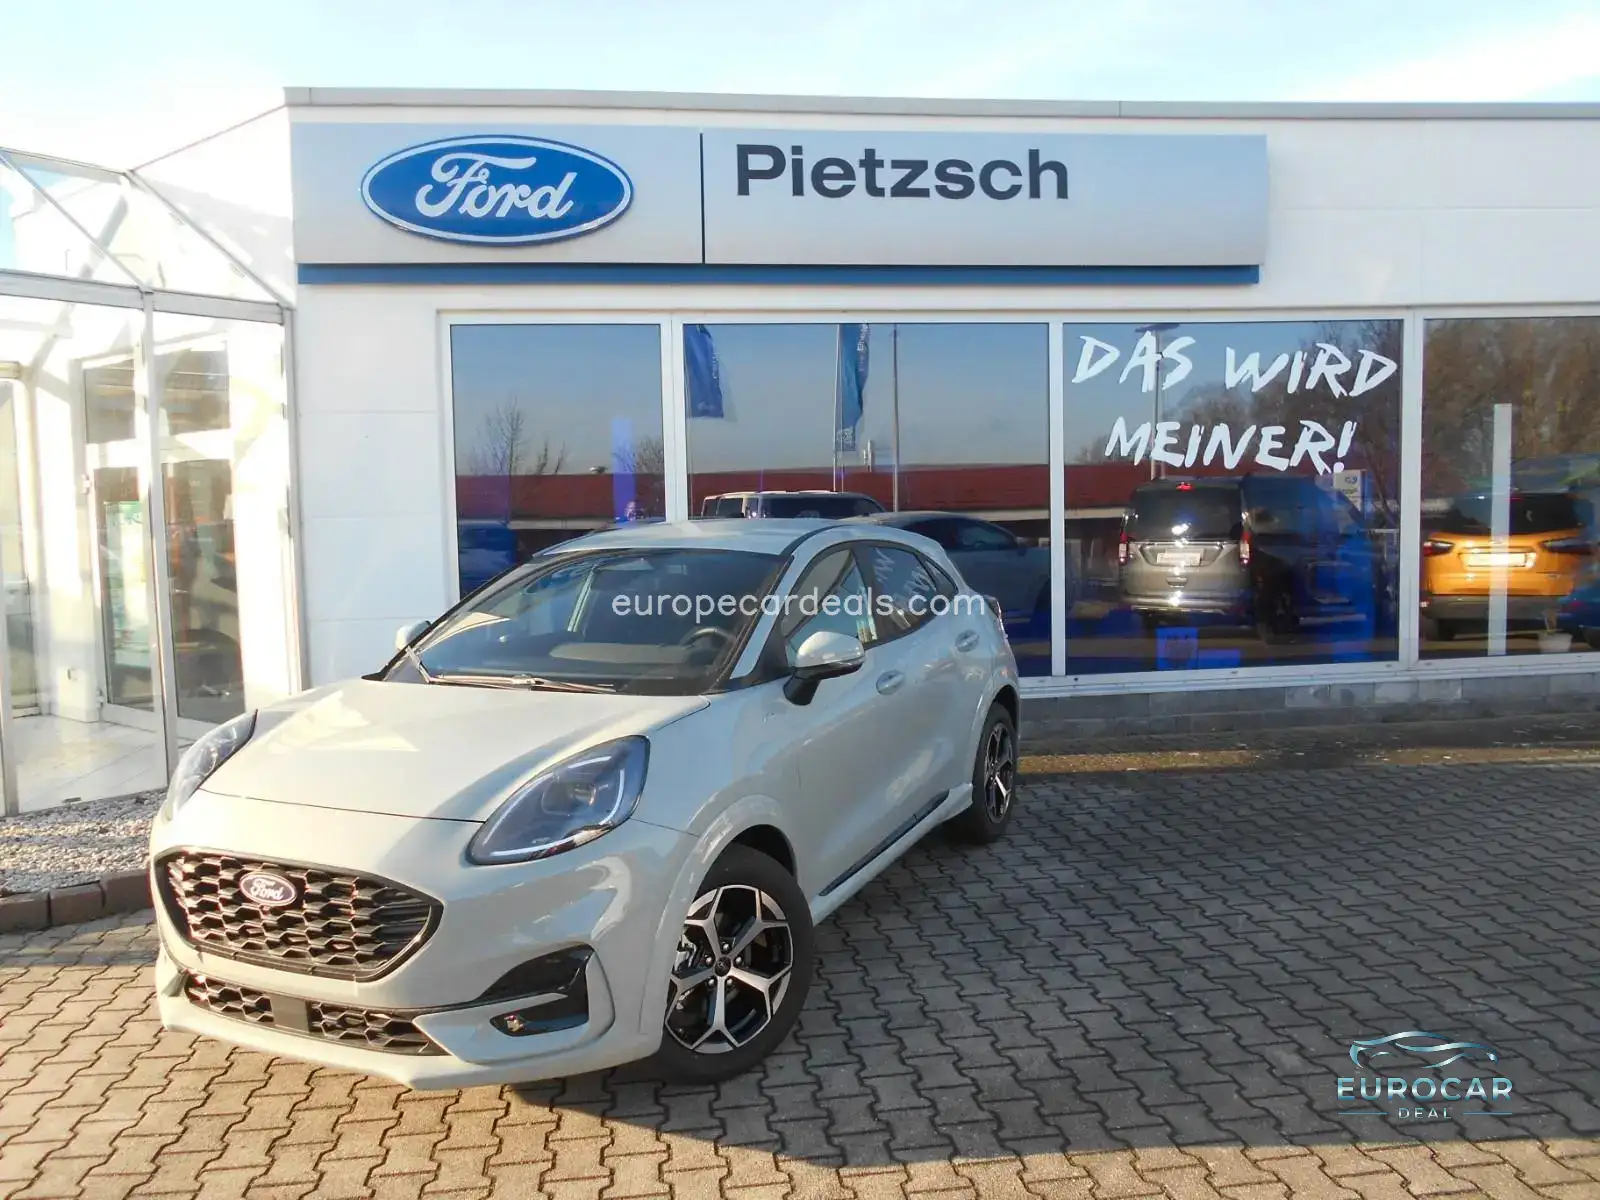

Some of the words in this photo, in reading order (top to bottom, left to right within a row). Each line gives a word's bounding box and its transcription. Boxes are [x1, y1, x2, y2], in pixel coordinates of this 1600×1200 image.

[416, 152, 577, 219] Ford
[736, 144, 1069, 200] Pietzsch
[1072, 331, 1196, 393] DAS
[1225, 343, 1398, 397] WIRD
[1105, 417, 1357, 475] MEINER!
[250, 878, 284, 900] Ford
